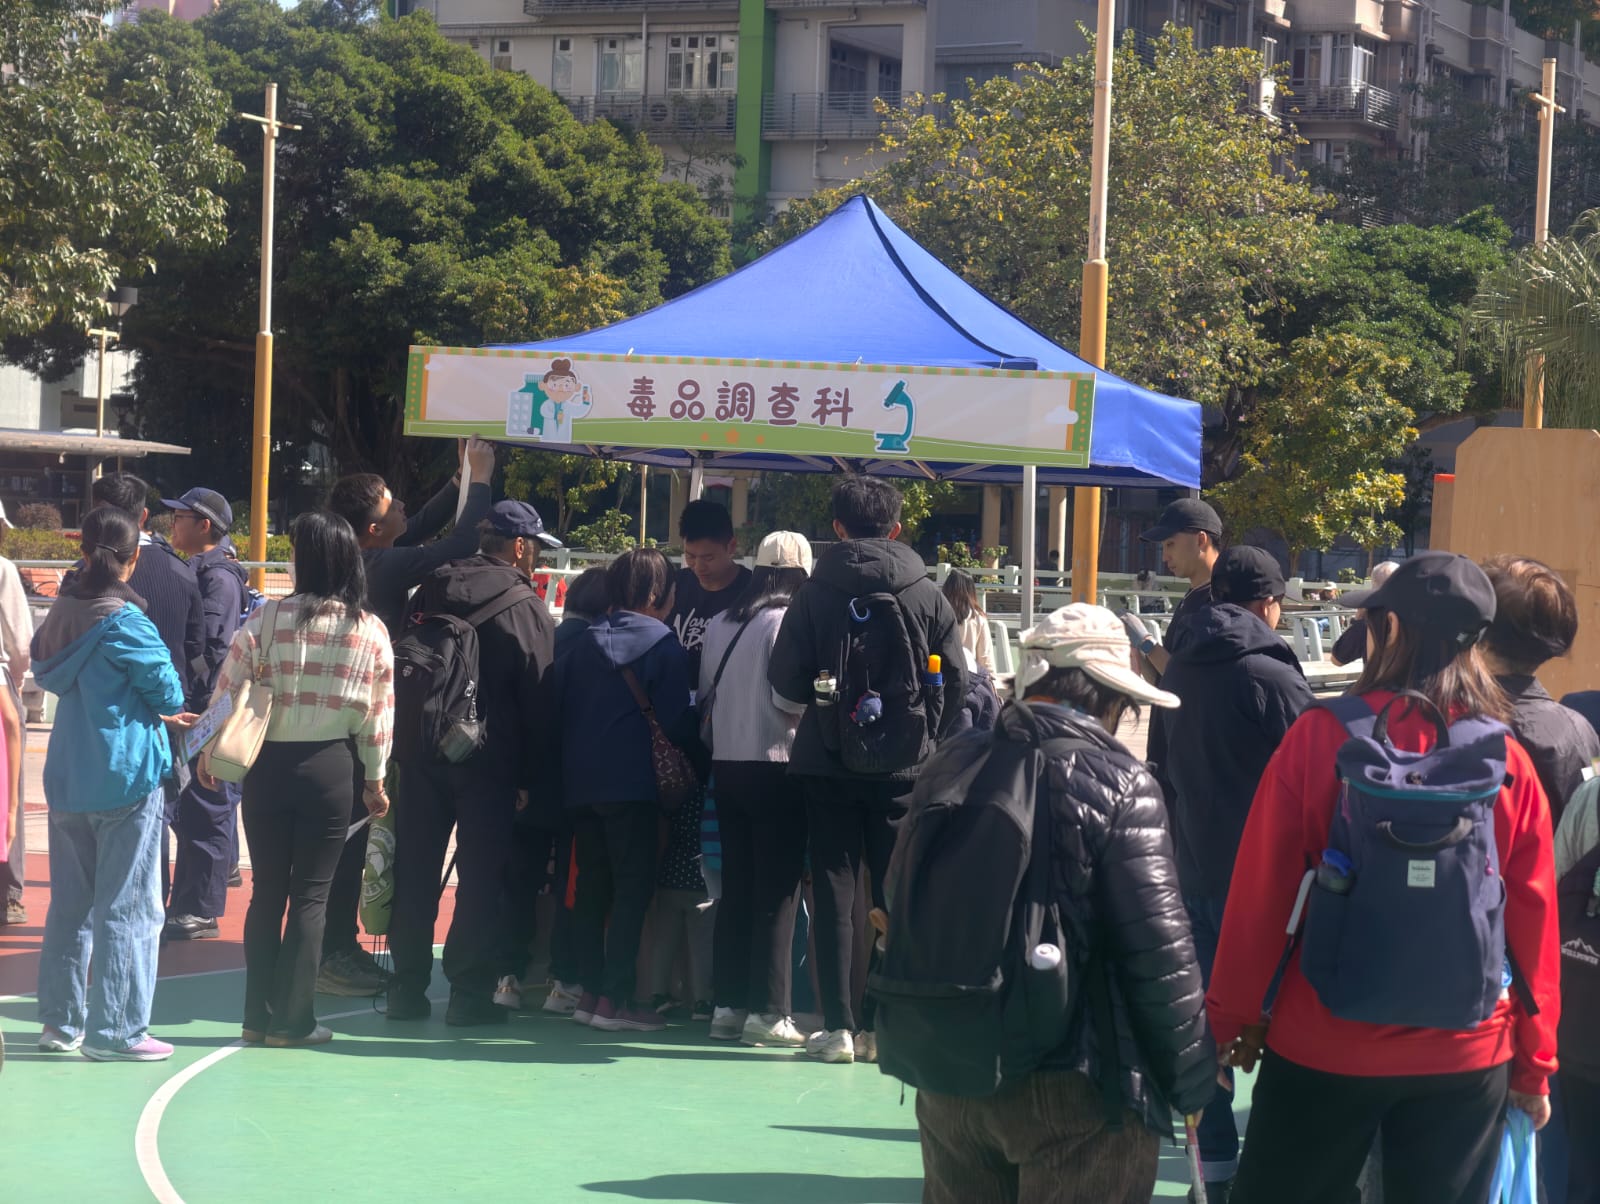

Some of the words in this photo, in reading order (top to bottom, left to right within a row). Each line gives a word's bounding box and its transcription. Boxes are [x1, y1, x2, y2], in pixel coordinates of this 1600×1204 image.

[627, 376, 853, 427] 毒品調查科
